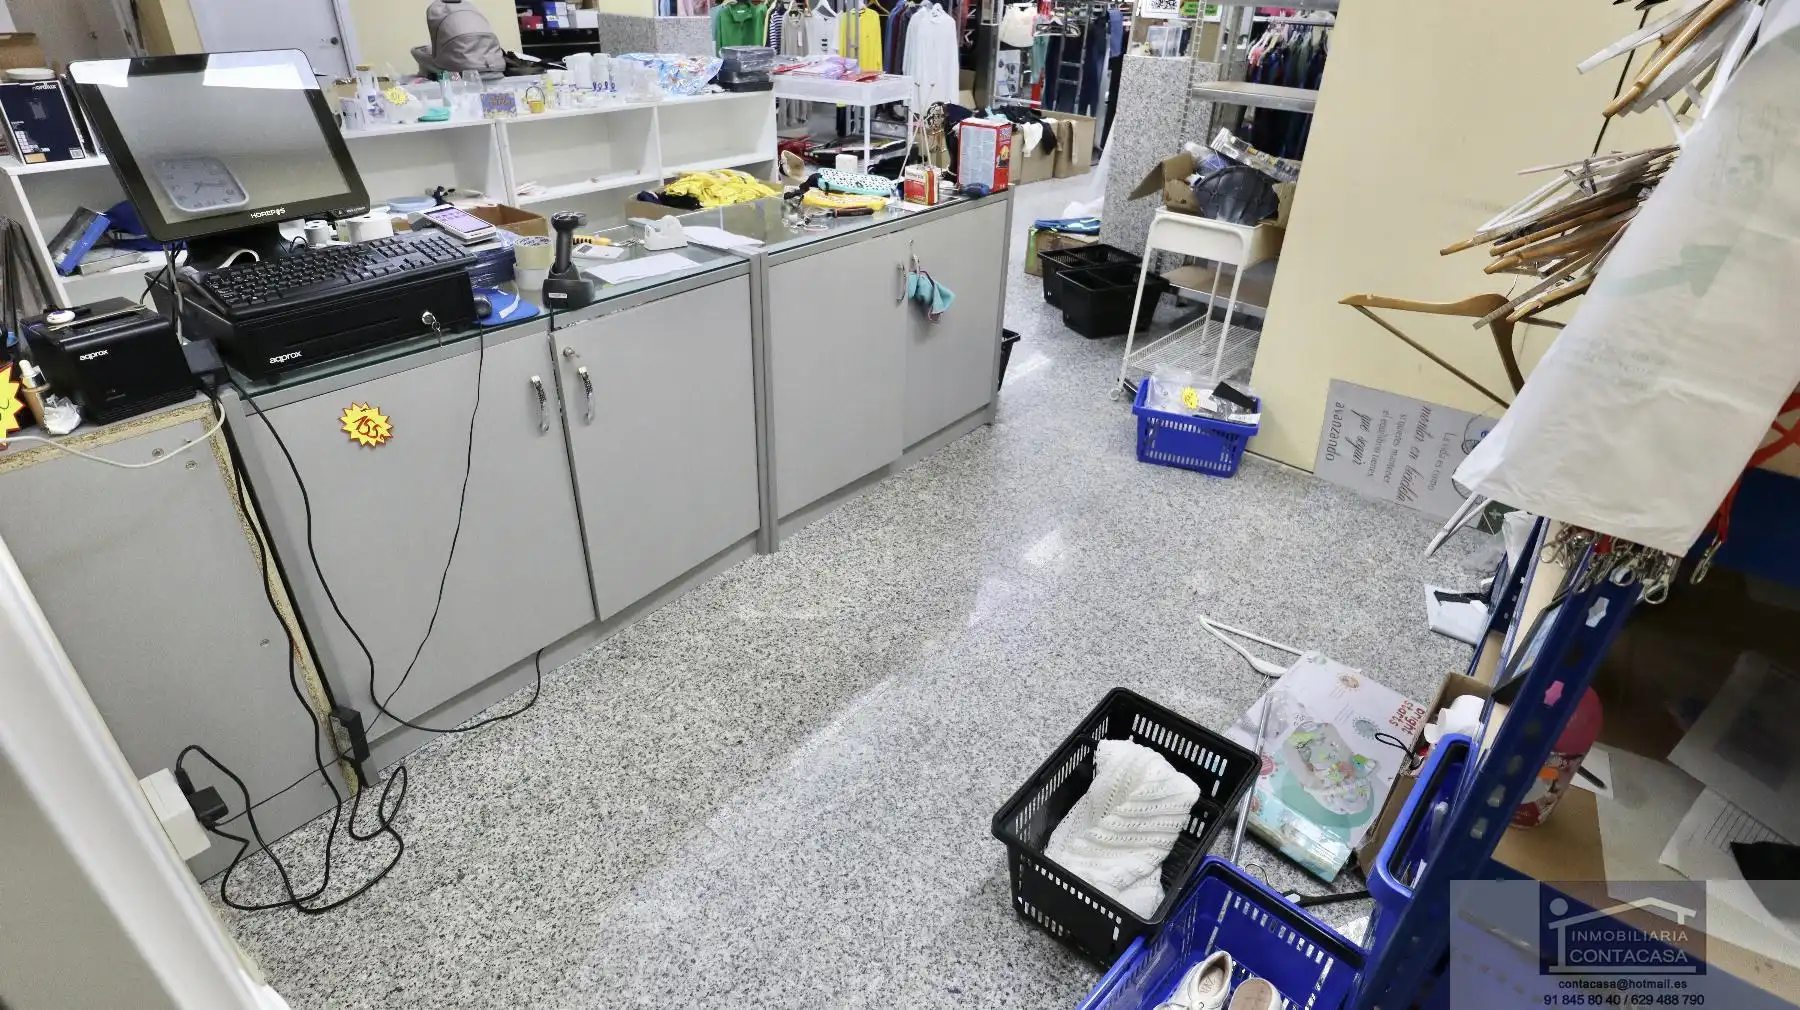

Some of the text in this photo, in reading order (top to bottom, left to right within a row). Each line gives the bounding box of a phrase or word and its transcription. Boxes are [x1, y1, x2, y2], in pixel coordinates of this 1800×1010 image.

[1325, 401, 1345, 461] avanzando
[1344, 409, 1372, 466] que seguir
